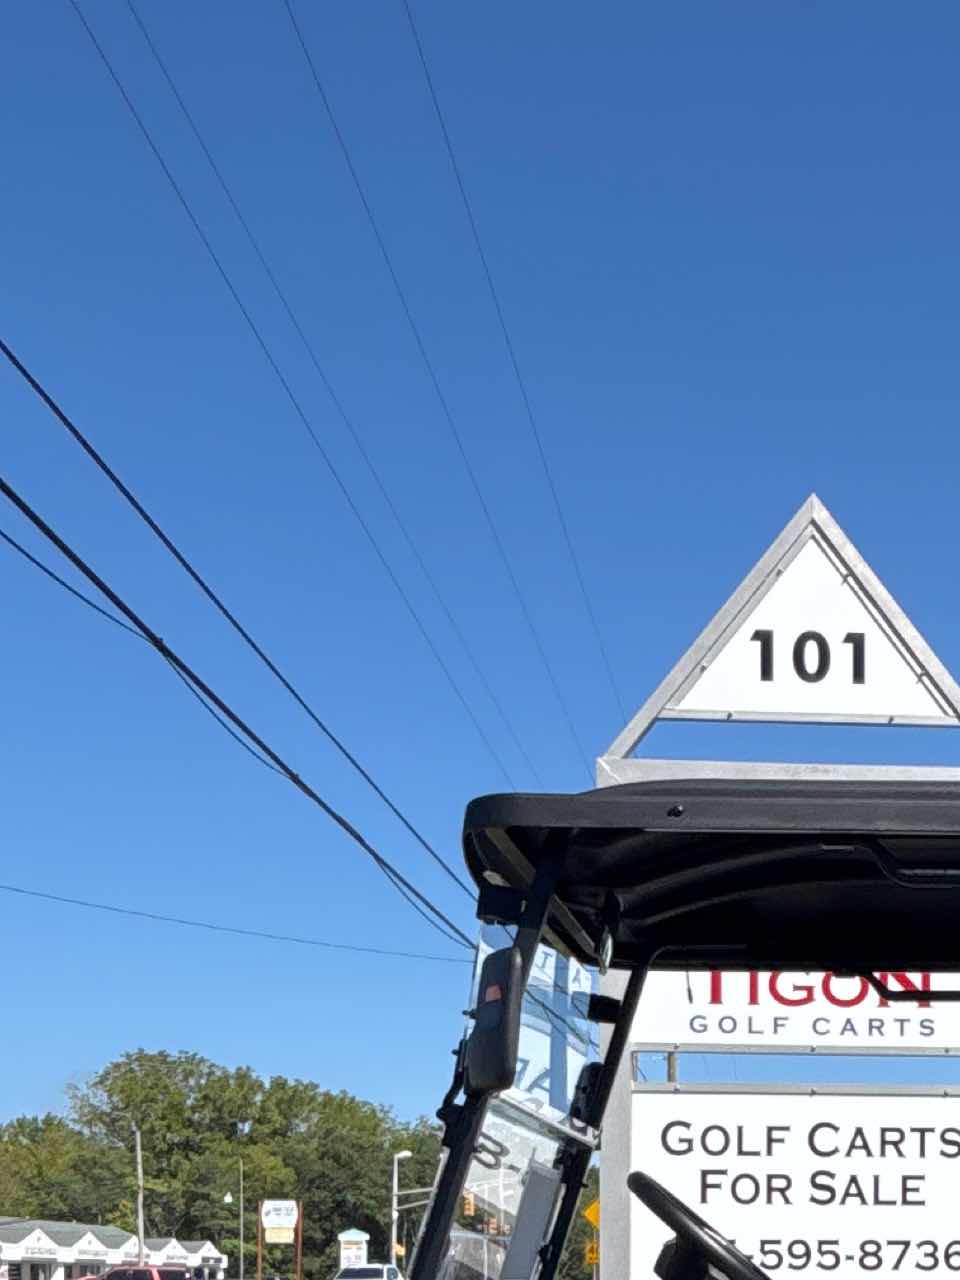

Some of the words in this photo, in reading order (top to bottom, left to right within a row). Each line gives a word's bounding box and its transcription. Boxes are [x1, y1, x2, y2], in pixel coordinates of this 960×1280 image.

[750, 629, 866, 684] 101
[689, 1014, 789, 1035] GOLF
[812, 1017, 935, 1037] CARTS
[661, 1120, 791, 1157] GOLF
[700, 1168, 793, 1205] FOR
[809, 1169, 926, 1207] SALE
